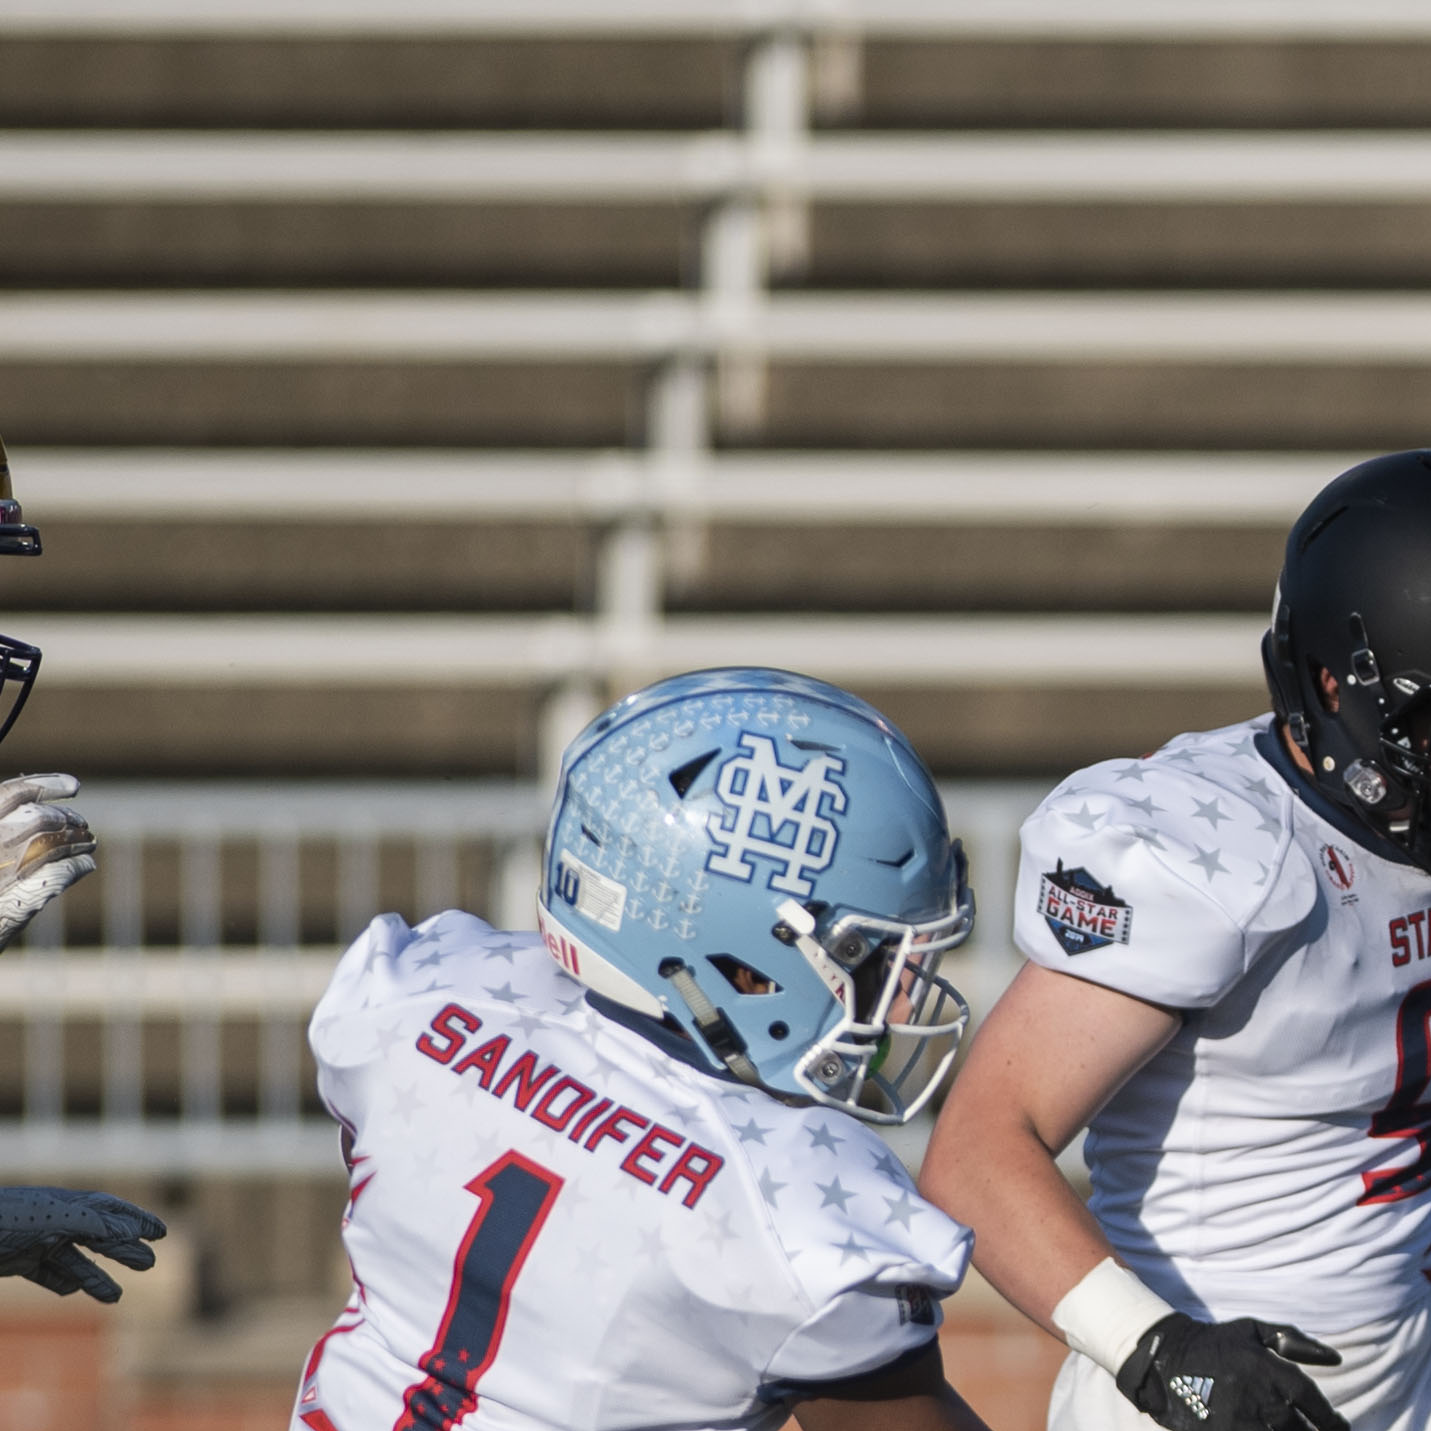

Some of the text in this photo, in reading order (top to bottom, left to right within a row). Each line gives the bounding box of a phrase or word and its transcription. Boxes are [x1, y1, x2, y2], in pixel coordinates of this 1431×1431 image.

[554, 861, 580, 906] 10
[1048, 885, 1118, 920] ALL-STAR
[1046, 896, 1117, 938] GAME
[415, 1002, 726, 1211] SANDIFER
